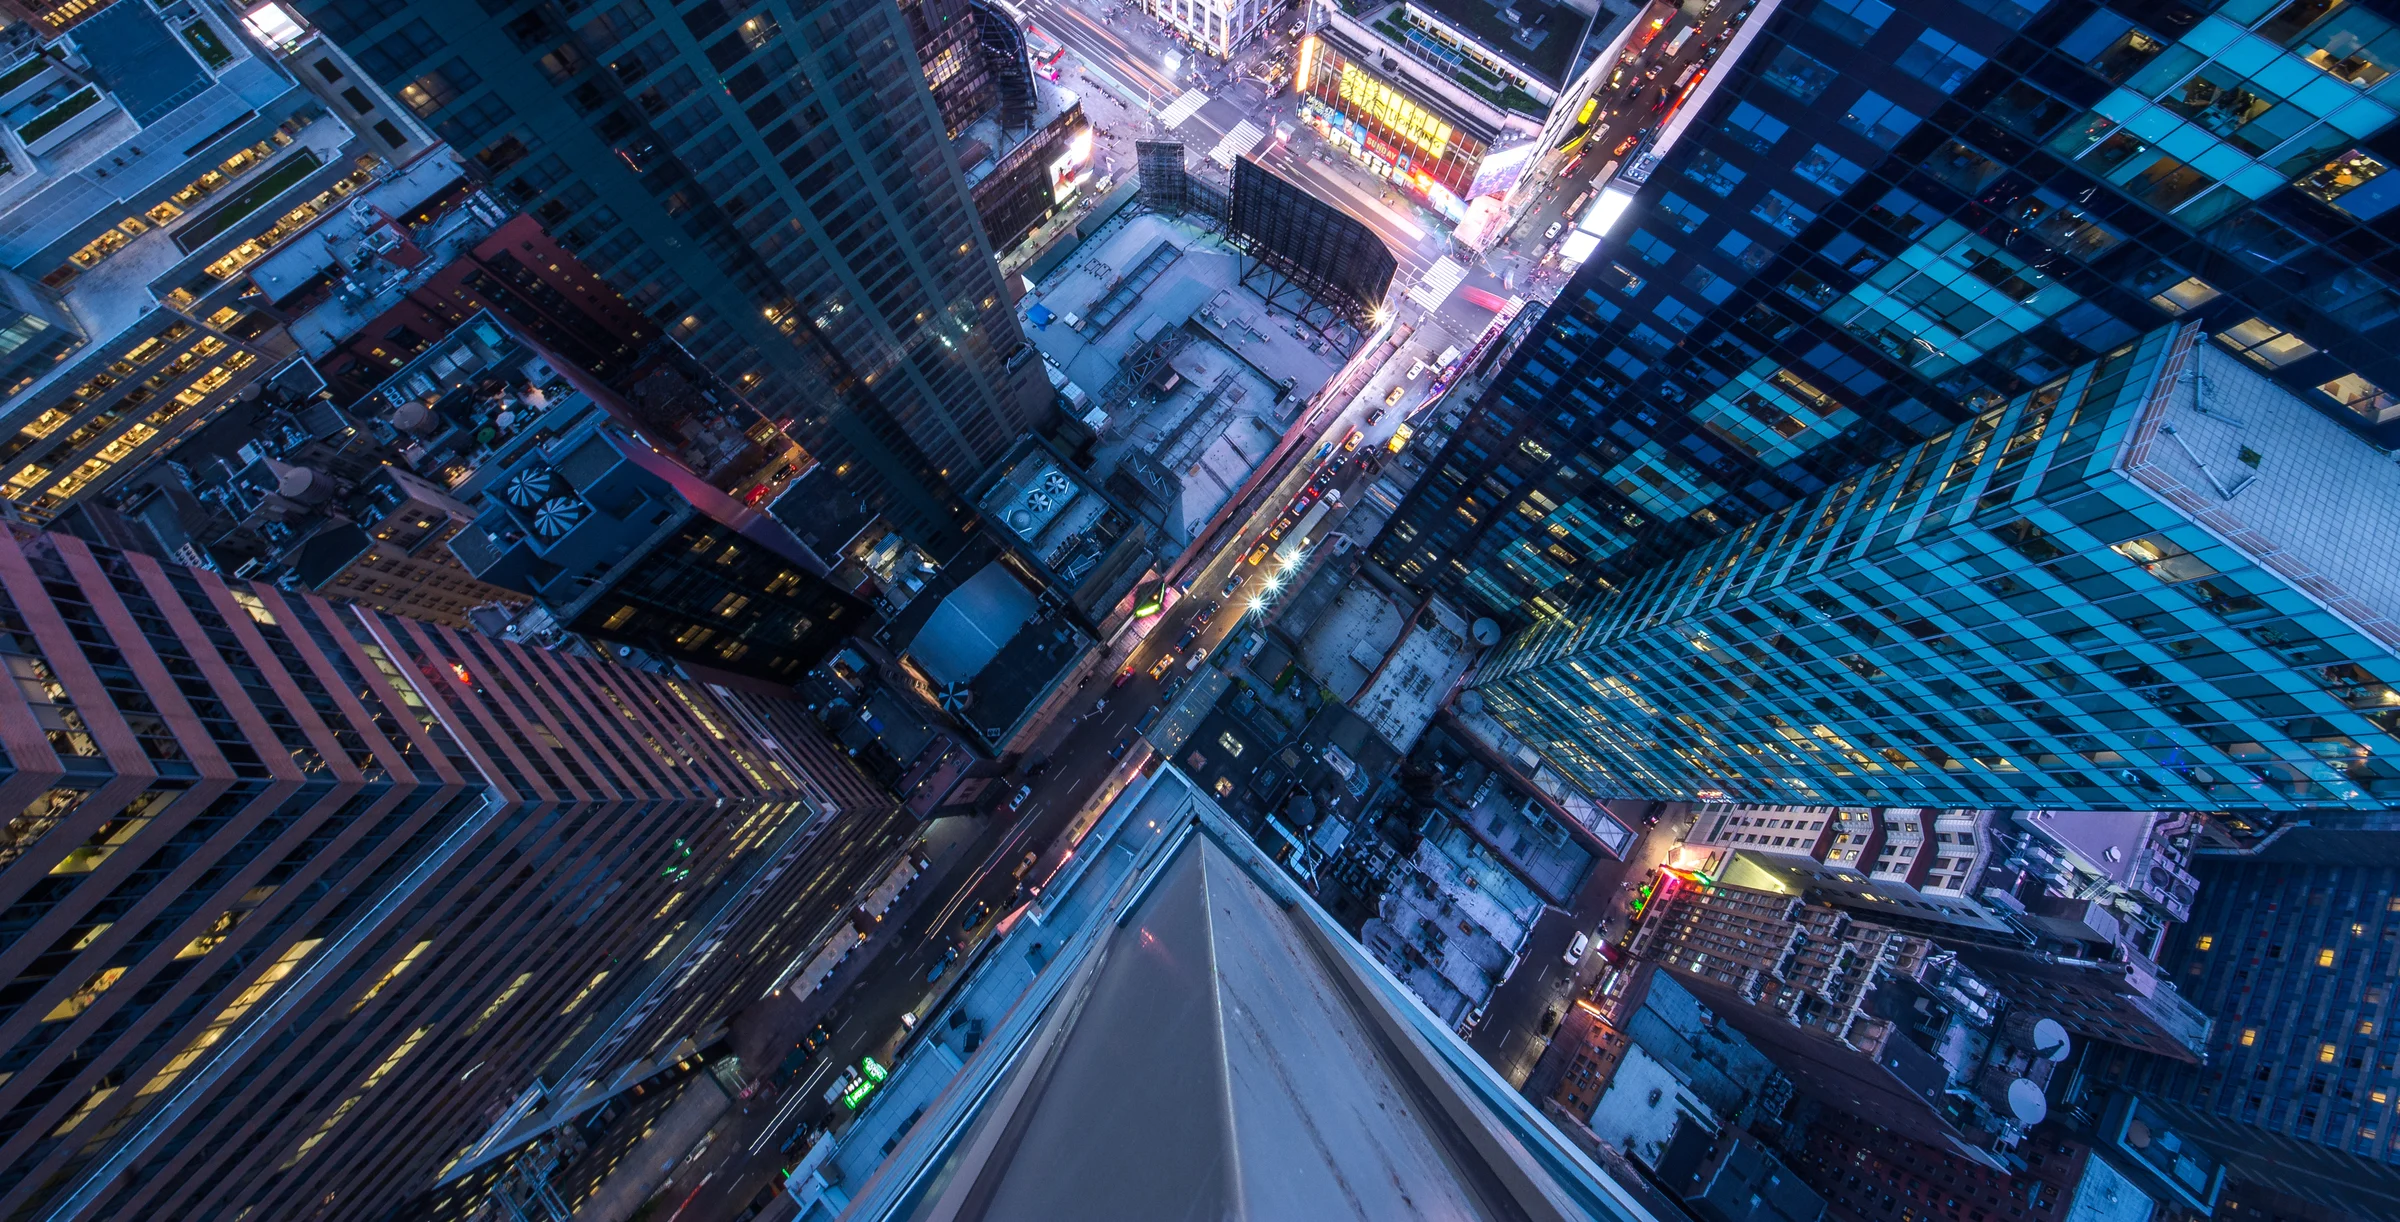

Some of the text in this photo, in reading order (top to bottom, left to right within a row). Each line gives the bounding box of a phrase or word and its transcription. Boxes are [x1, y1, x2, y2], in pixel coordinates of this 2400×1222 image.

[1389, 109, 1440, 148] LION KING
[1366, 136, 1397, 160] SUNDAY
